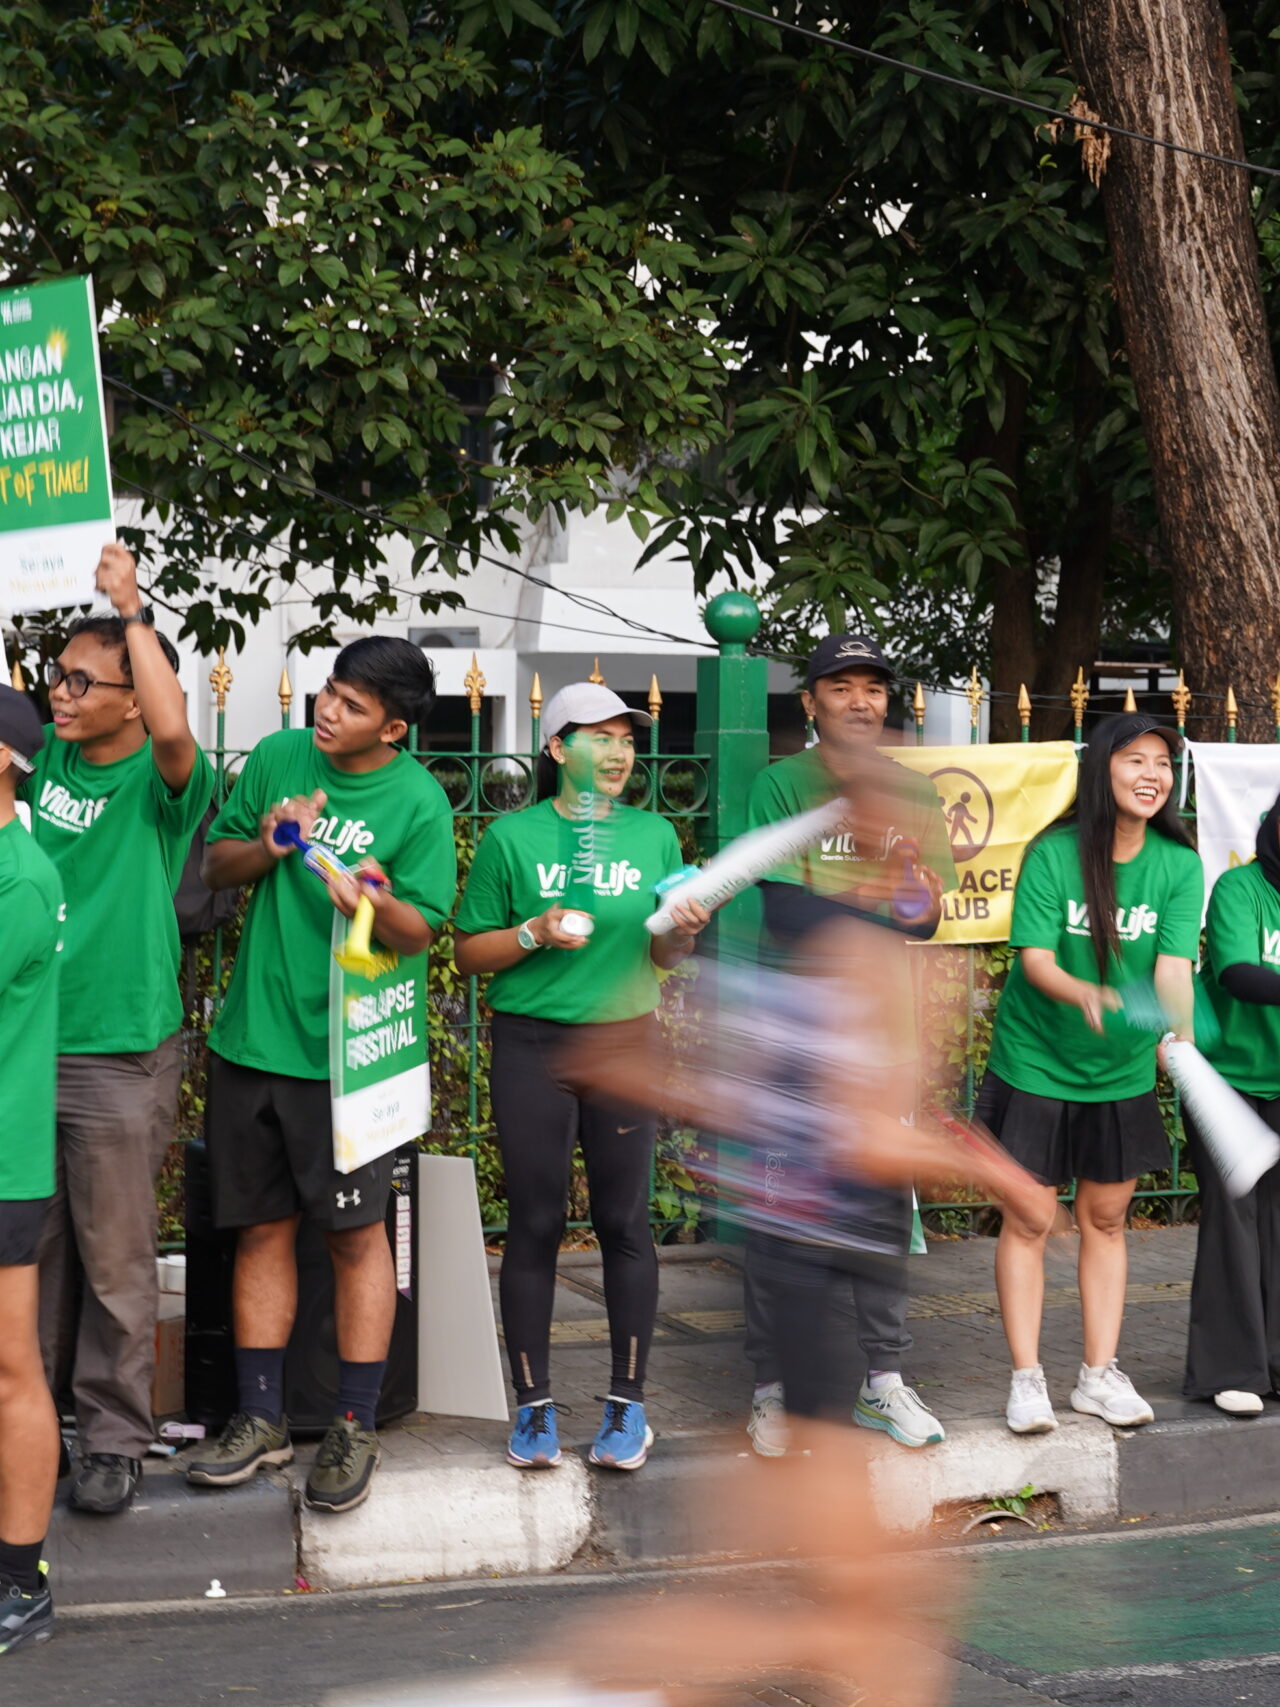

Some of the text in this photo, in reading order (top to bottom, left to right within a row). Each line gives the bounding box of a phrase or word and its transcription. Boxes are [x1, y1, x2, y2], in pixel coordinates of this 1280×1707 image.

[38, 378, 83, 414] DIA,
[39, 779, 109, 828] VitaLif
[958, 868, 1014, 893] ACE
[942, 897, 990, 921] LUB
[346, 1016, 418, 1071] FESTIVAL
